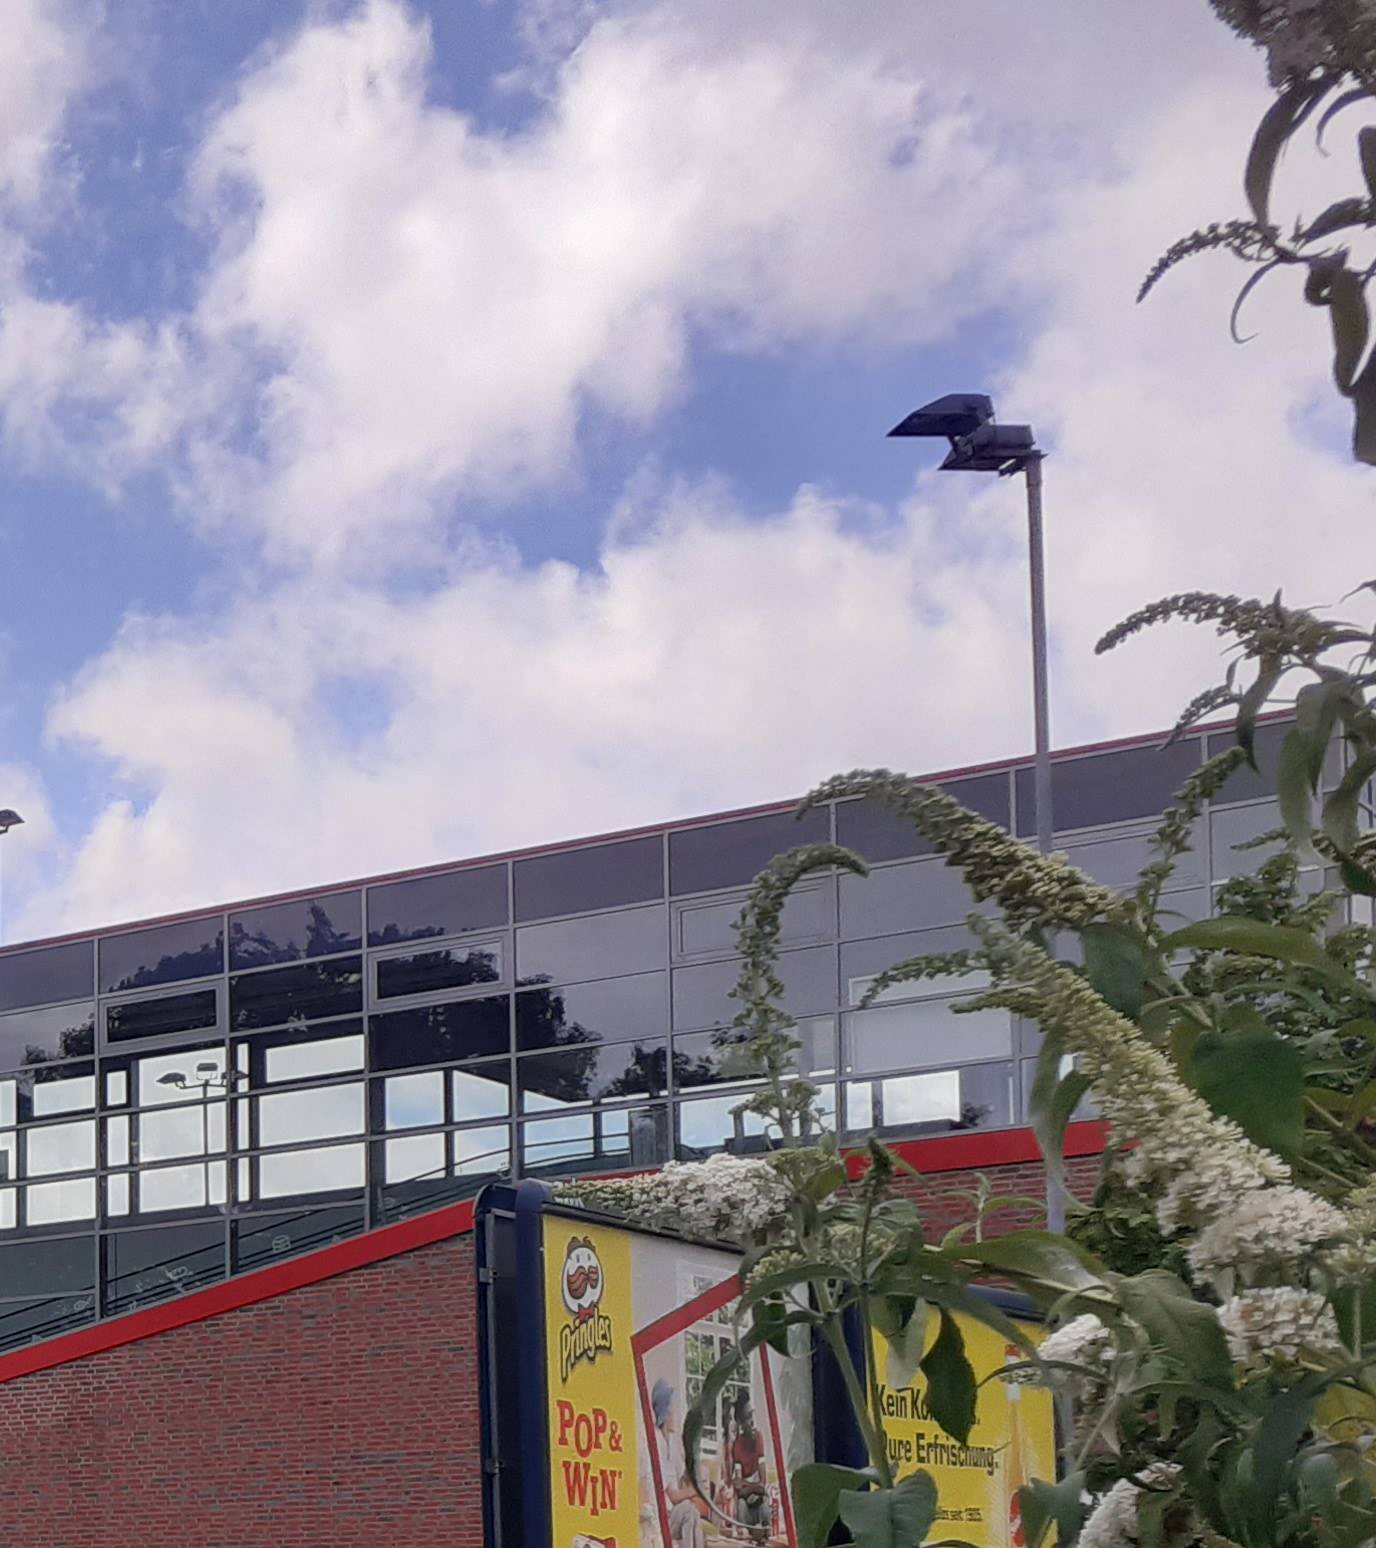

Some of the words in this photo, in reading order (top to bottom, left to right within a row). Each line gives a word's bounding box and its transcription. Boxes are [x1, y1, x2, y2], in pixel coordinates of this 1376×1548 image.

[560, 1305, 612, 1384] Pringles
[556, 1399, 607, 1458] POP
[608, 1420, 623, 1453] &
[916, 1433, 999, 1476] Erfrischung.
